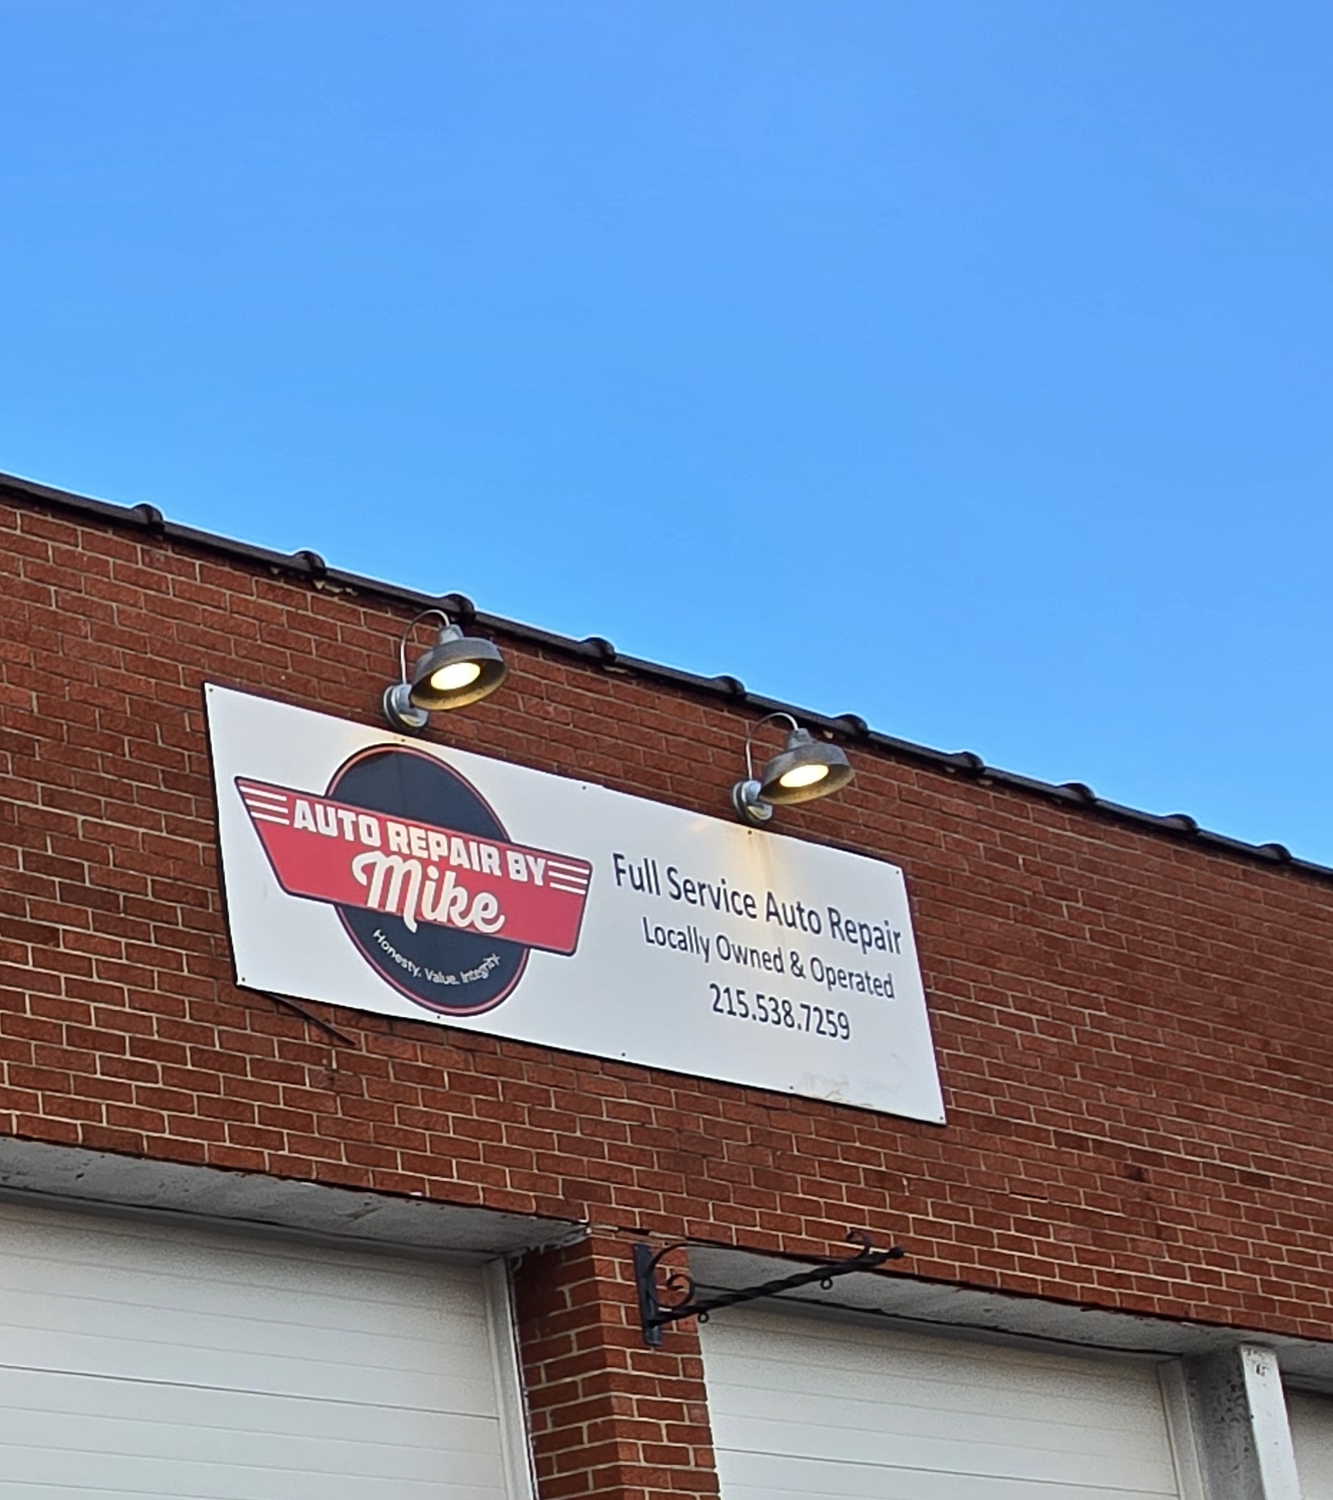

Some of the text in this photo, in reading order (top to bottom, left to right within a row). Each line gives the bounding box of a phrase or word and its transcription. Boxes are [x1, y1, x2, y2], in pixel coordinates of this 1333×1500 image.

[293, 799, 549, 887] AUTO REPAIR BY
[351, 850, 505, 934] Mike
[612, 852, 902, 955] Full Service Auto Repair
[642, 916, 896, 1000] Locally Owned & Operated
[709, 982, 851, 1041] 215.538.7259
